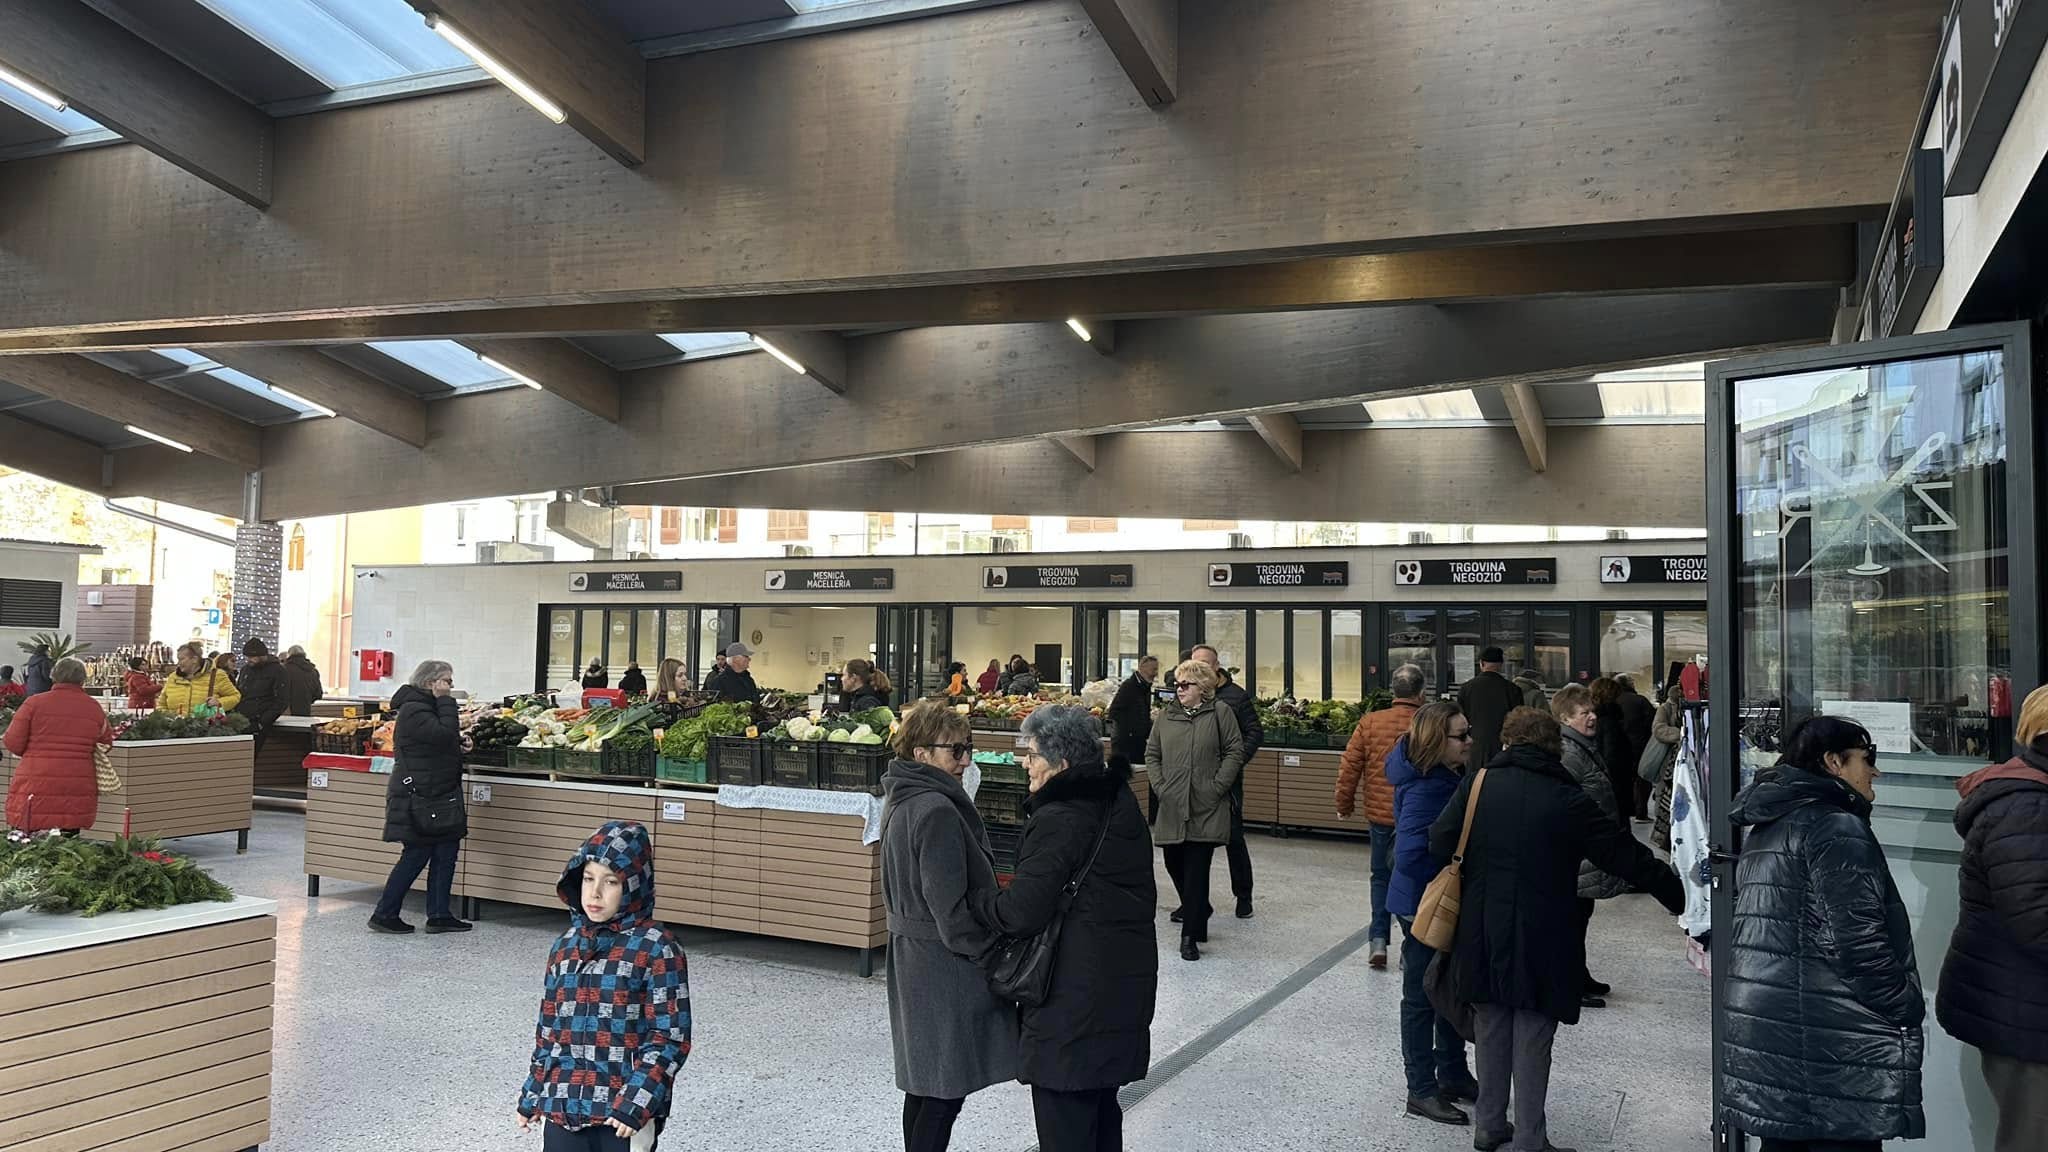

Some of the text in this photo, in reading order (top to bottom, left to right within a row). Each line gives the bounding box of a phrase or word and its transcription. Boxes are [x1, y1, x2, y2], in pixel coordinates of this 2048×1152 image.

[1449, 561, 1506, 573] TRGOVINA
[1662, 558, 1707, 570] TRGOVI
[1037, 568, 1079, 577] TRGOVINA
[1256, 564, 1305, 575] TRGOVINA
[611, 573, 640, 581] MESNICA
[813, 571, 844, 580] MESNICA
[1453, 572, 1502, 583] NEGOZIO
[1666, 569, 1707, 581] NEGOZ
[807, 579, 851, 588] MACELLERIA
[1040, 577, 1077, 586] NEGOZIO
[1259, 575, 1302, 585] NEGOZIO
[606, 581, 645, 589] MACELLERIA
[312, 776, 322, 785] 45
[473, 790, 485, 800] 46
